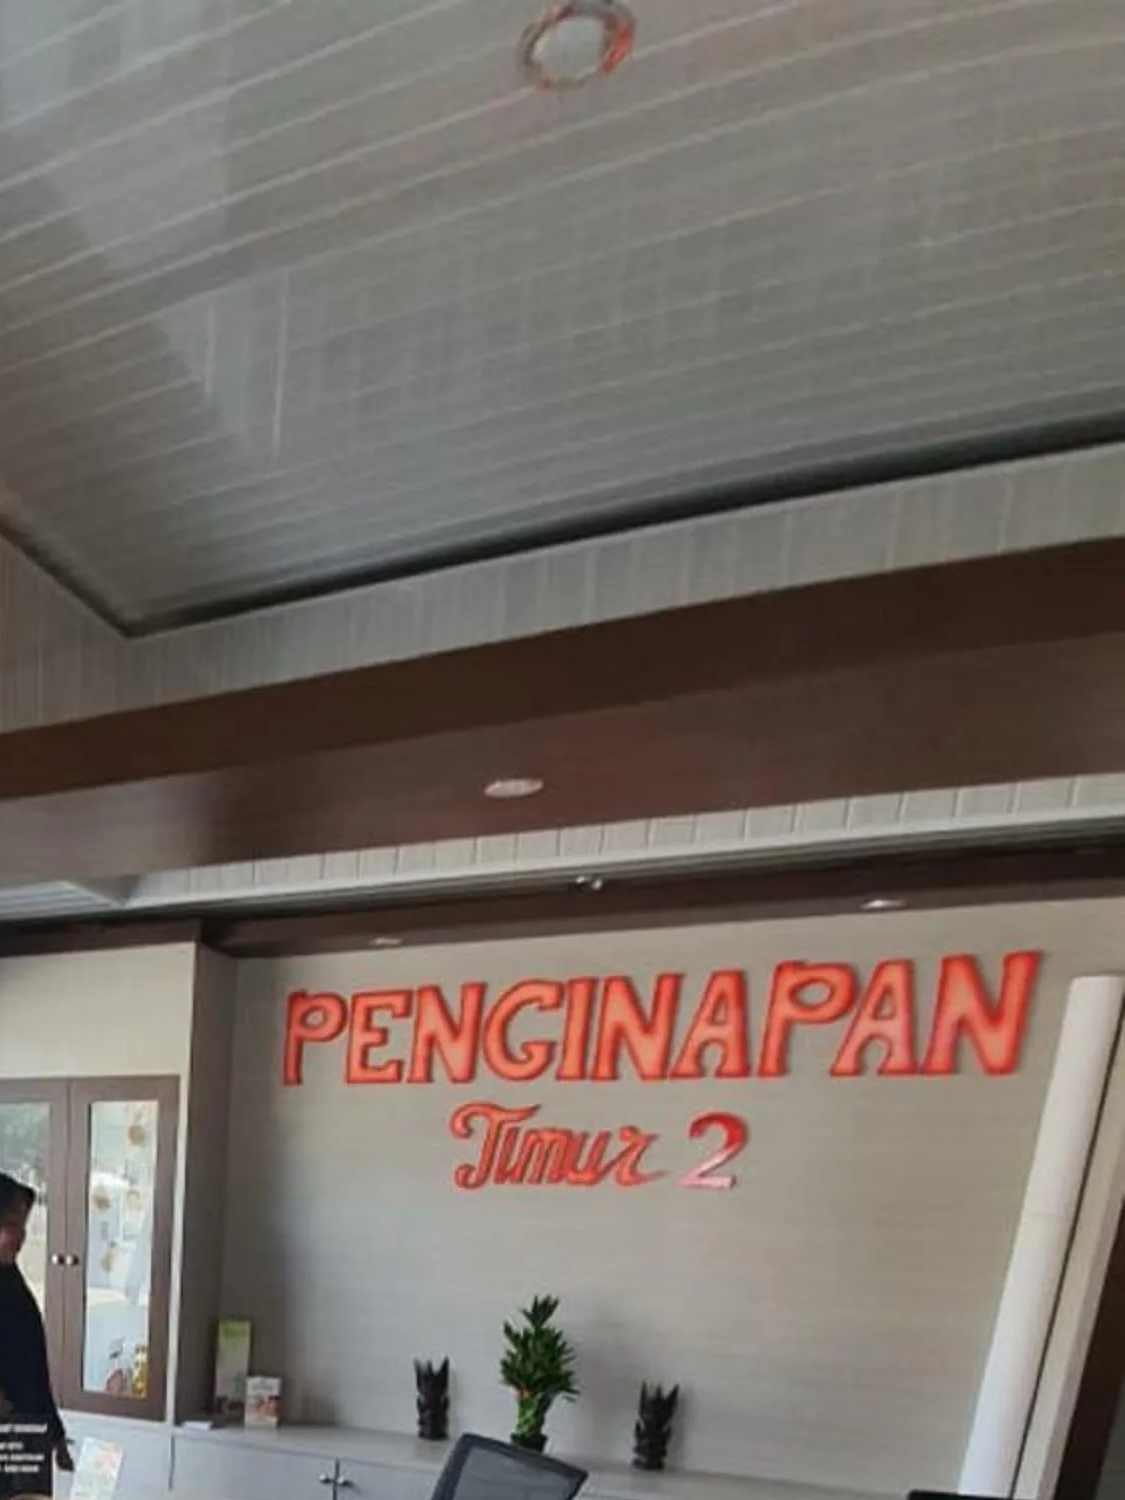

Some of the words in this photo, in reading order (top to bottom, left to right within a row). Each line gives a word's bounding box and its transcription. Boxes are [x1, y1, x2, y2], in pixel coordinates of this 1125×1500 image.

[283, 949, 1042, 1086] PENGINAPAN
[449, 1102, 666, 1189] Timur
[679, 1111, 750, 1190] 2
